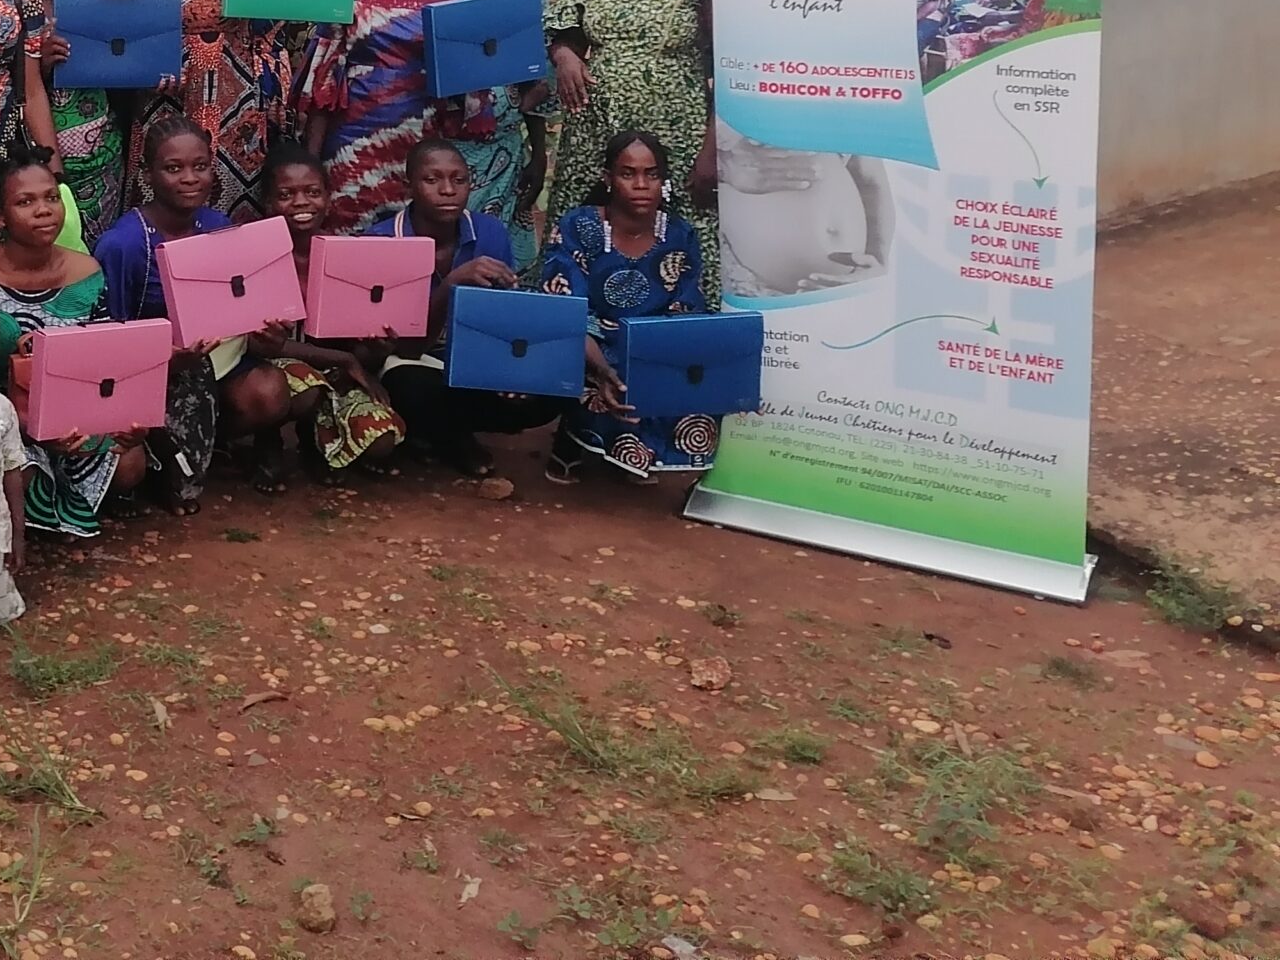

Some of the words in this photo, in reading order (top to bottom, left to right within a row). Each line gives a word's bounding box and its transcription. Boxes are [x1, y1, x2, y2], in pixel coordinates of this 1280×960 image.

[720, 56, 744, 70] Cible
[762, 62, 776, 72] DE
[779, 61, 809, 74] 160
[811, 66, 916, 80] ADOLESCENT(E)S
[996, 64, 1077, 81] Information
[729, 78, 750, 91] Lieu
[759, 82, 831, 97] BOHICON
[835, 87, 848, 97] &
[850, 87, 902, 100] TOFFO
[1006, 84, 1070, 97] complète
[1014, 102, 1030, 111] en
[1034, 100, 1060, 114] SSR
[956, 199, 998, 214] CHOIX
[1002, 201, 1058, 221] ÉCLAIRÉ
[954, 215, 970, 227] DE
[974, 217, 990, 229] LA
[993, 221, 1063, 239] JEUNESSE
[971, 234, 1007, 249] POUR
[1012, 239, 1040, 253] UNE
[970, 251, 1040, 270] SEXUALITÉ
[961, 266, 1054, 289] RESPONSABLE
[775, 345, 789, 355] et
[938, 340, 980, 357] SANTÉ
[984, 347, 1001, 360] DE
[1005, 350, 1022, 363] LA
[1026, 352, 1064, 370] MÈRE
[949, 357, 964, 369] ET
[968, 360, 984, 373] DE
[989, 363, 1055, 385] L'ENFANT
[817, 390, 870, 410] Contacts
[874, 400, 904, 417] ONG
[771, 421, 795, 432] 1824
[780, 404, 794, 416] de
[797, 406, 838, 424] Jeunes
[843, 413, 903, 436] Chrétiens
[907, 428, 937, 442] pour
[942, 431, 955, 444] le
[959, 433, 1057, 465] Développement
